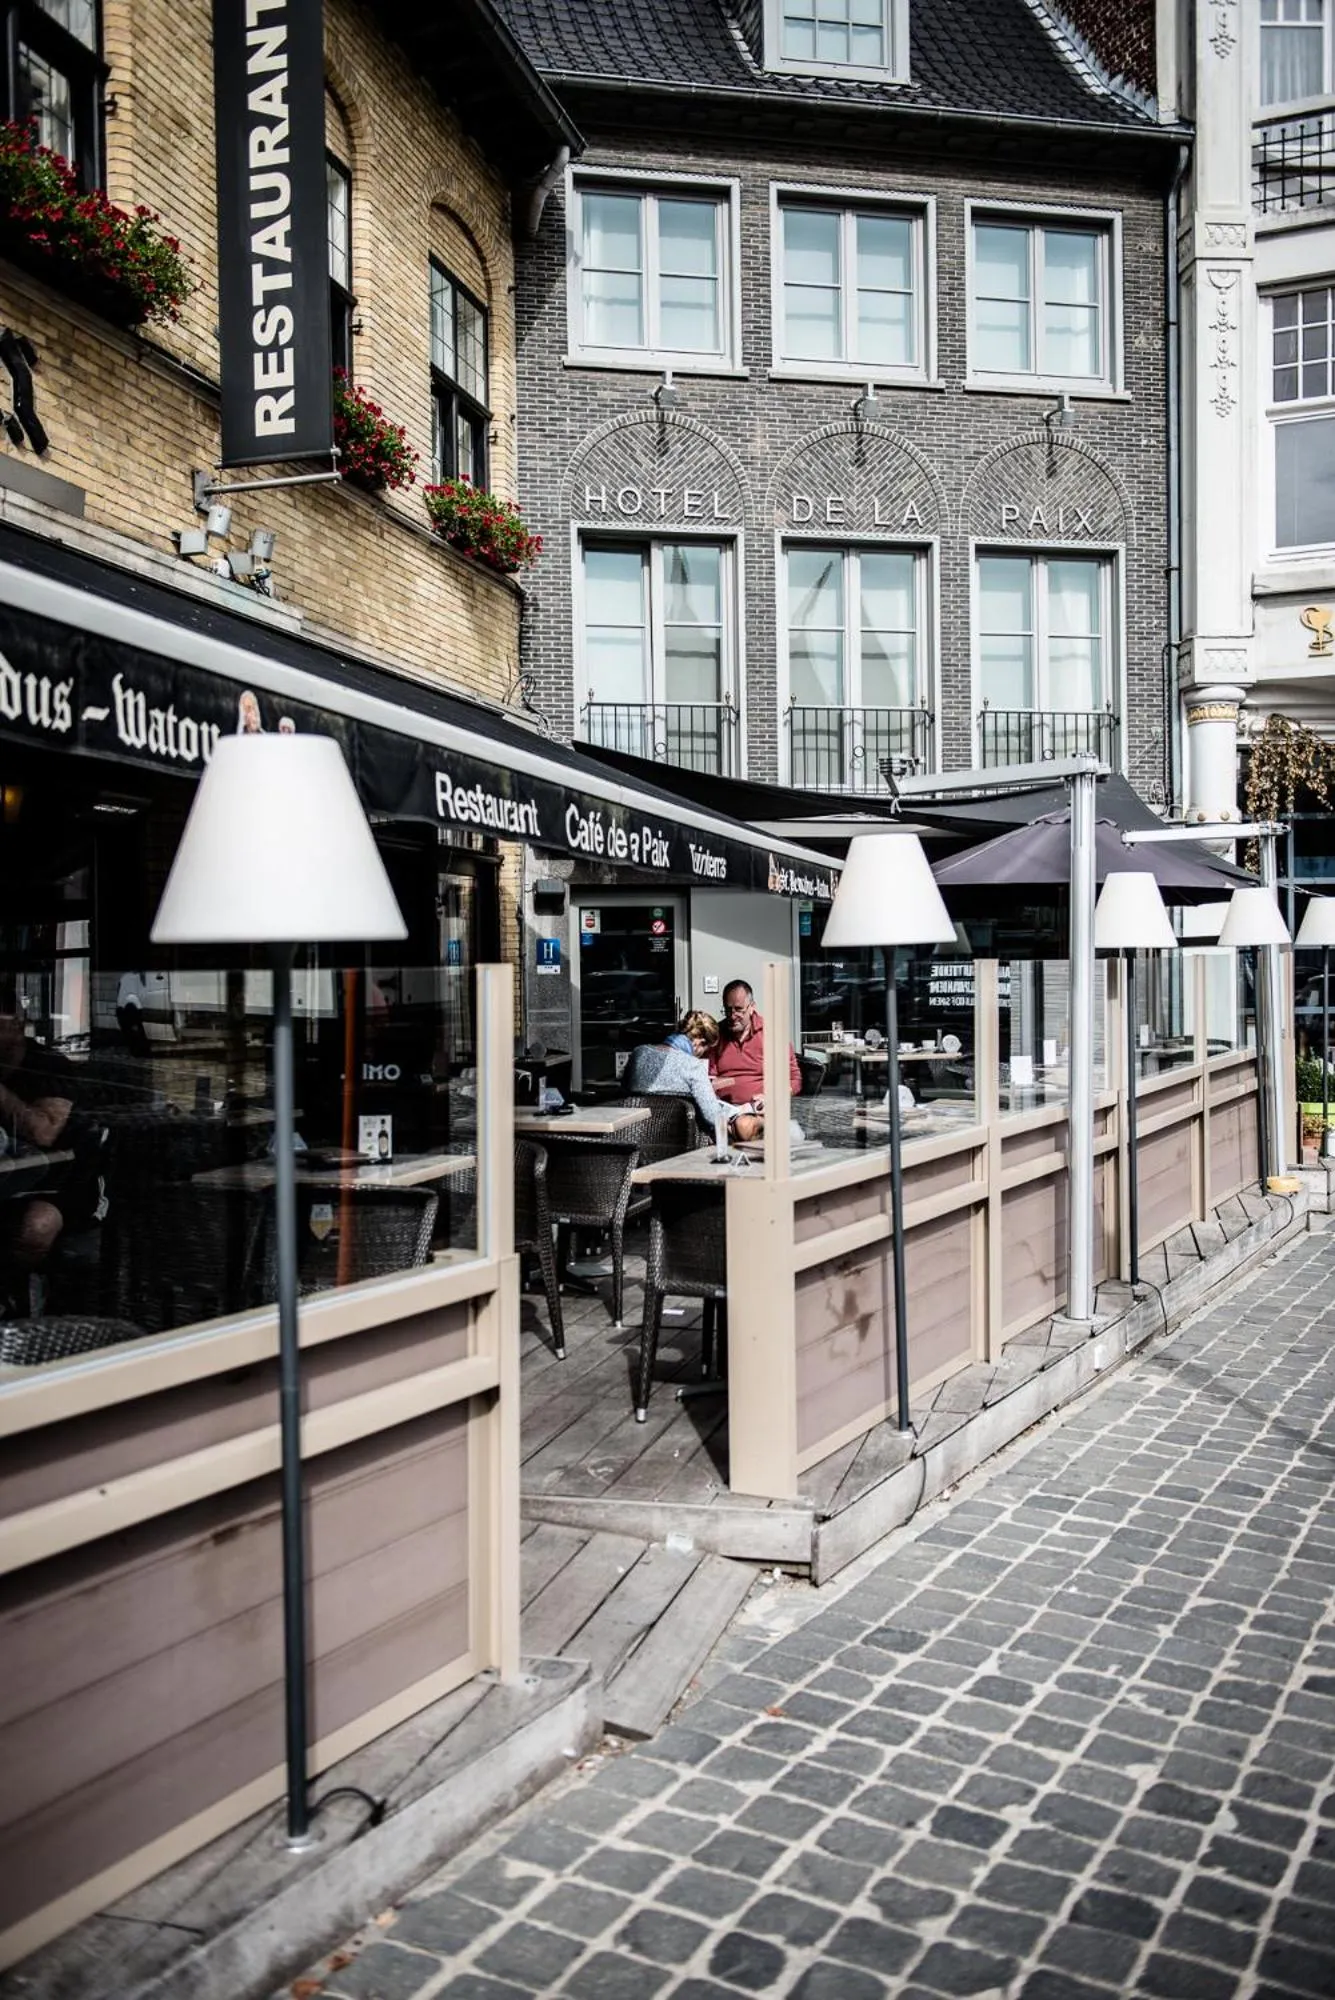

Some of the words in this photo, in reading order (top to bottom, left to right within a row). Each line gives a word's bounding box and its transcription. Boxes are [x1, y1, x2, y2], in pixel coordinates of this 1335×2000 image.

[246, 0, 295, 437] RESTAURANT
[585, 485, 731, 520] HOTEL
[792, 496, 845, 524] DE
[873, 497, 924, 528] LA
[1001, 503, 1095, 534] PAIX
[435, 771, 541, 837] Restaurant
[565, 802, 605, 855] Café
[607, 817, 628, 858] de
[642, 825, 670, 868] Paix
[543, 942, 554, 960] H
